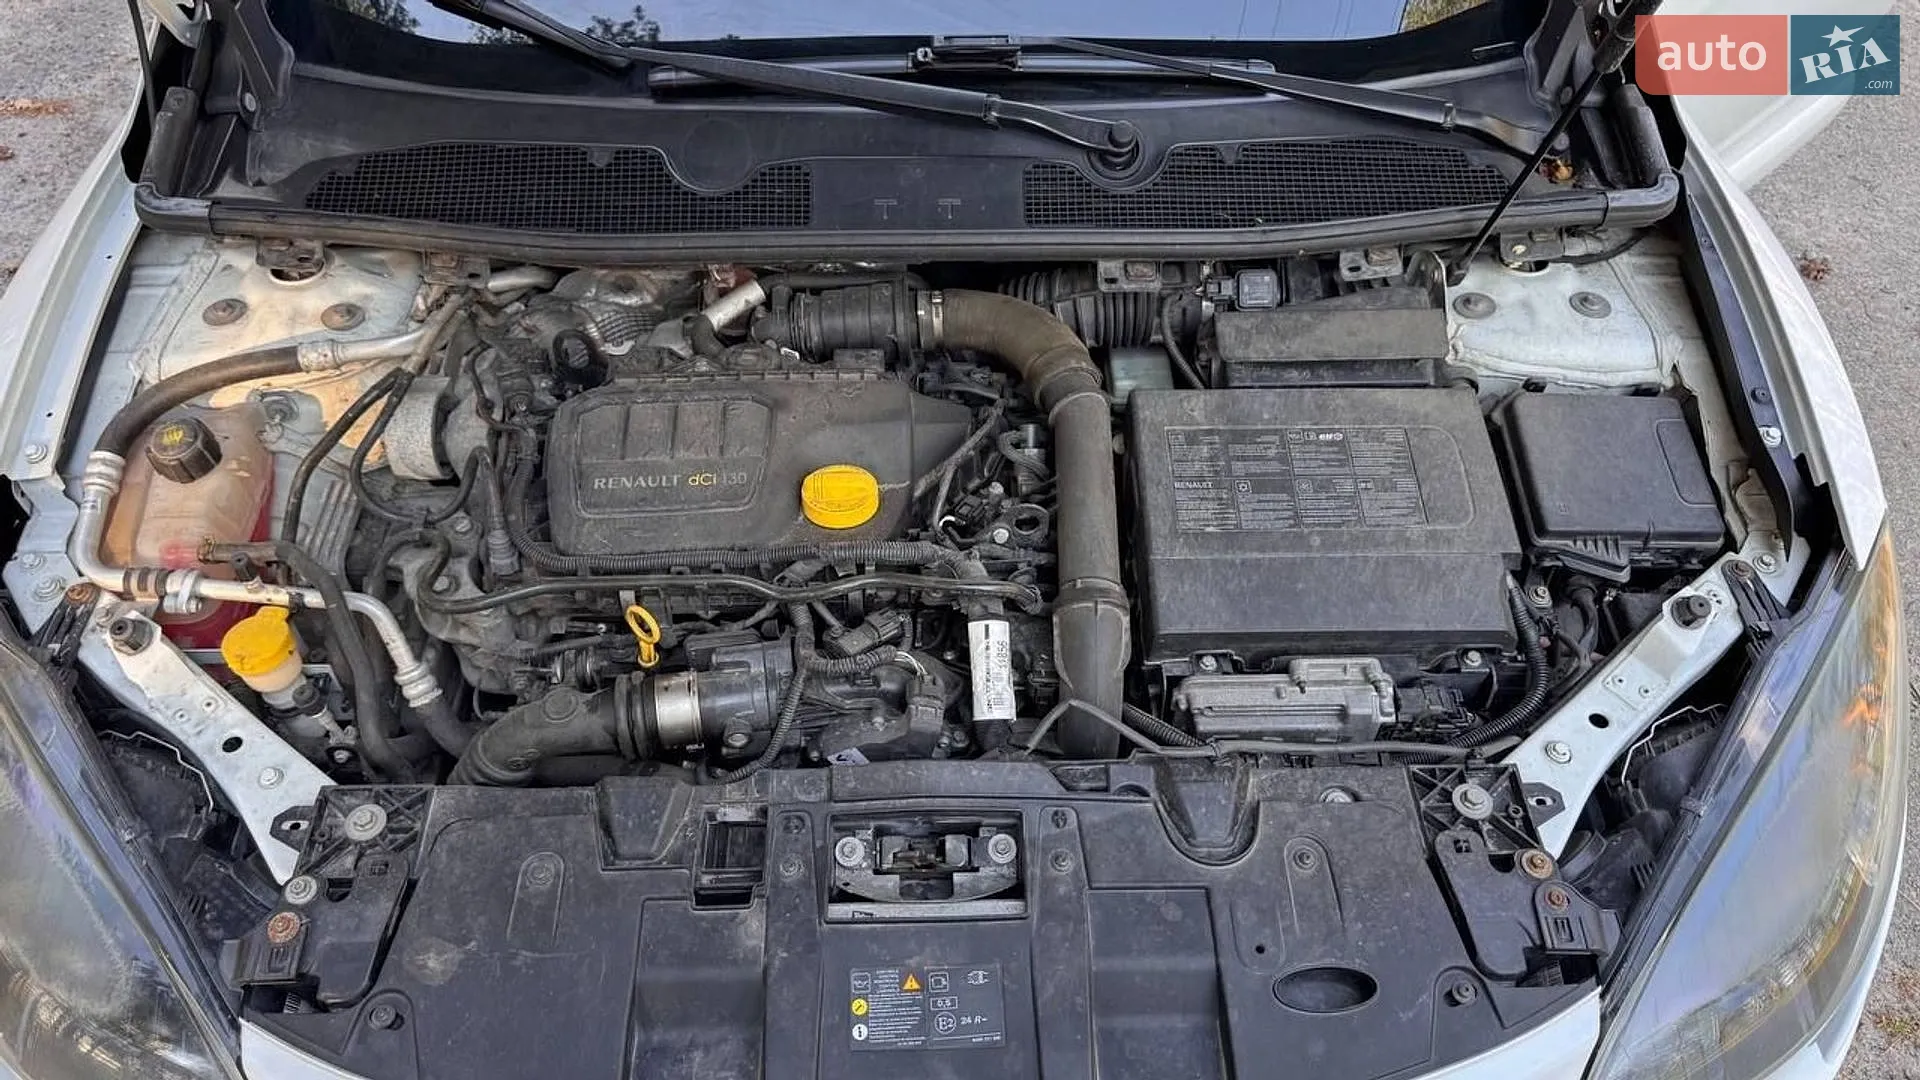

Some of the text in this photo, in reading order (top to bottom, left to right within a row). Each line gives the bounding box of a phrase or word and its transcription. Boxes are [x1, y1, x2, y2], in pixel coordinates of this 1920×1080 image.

[593, 472, 747, 489] RENAULT dCi 130
[1174, 481, 1214, 489] RENAULT
